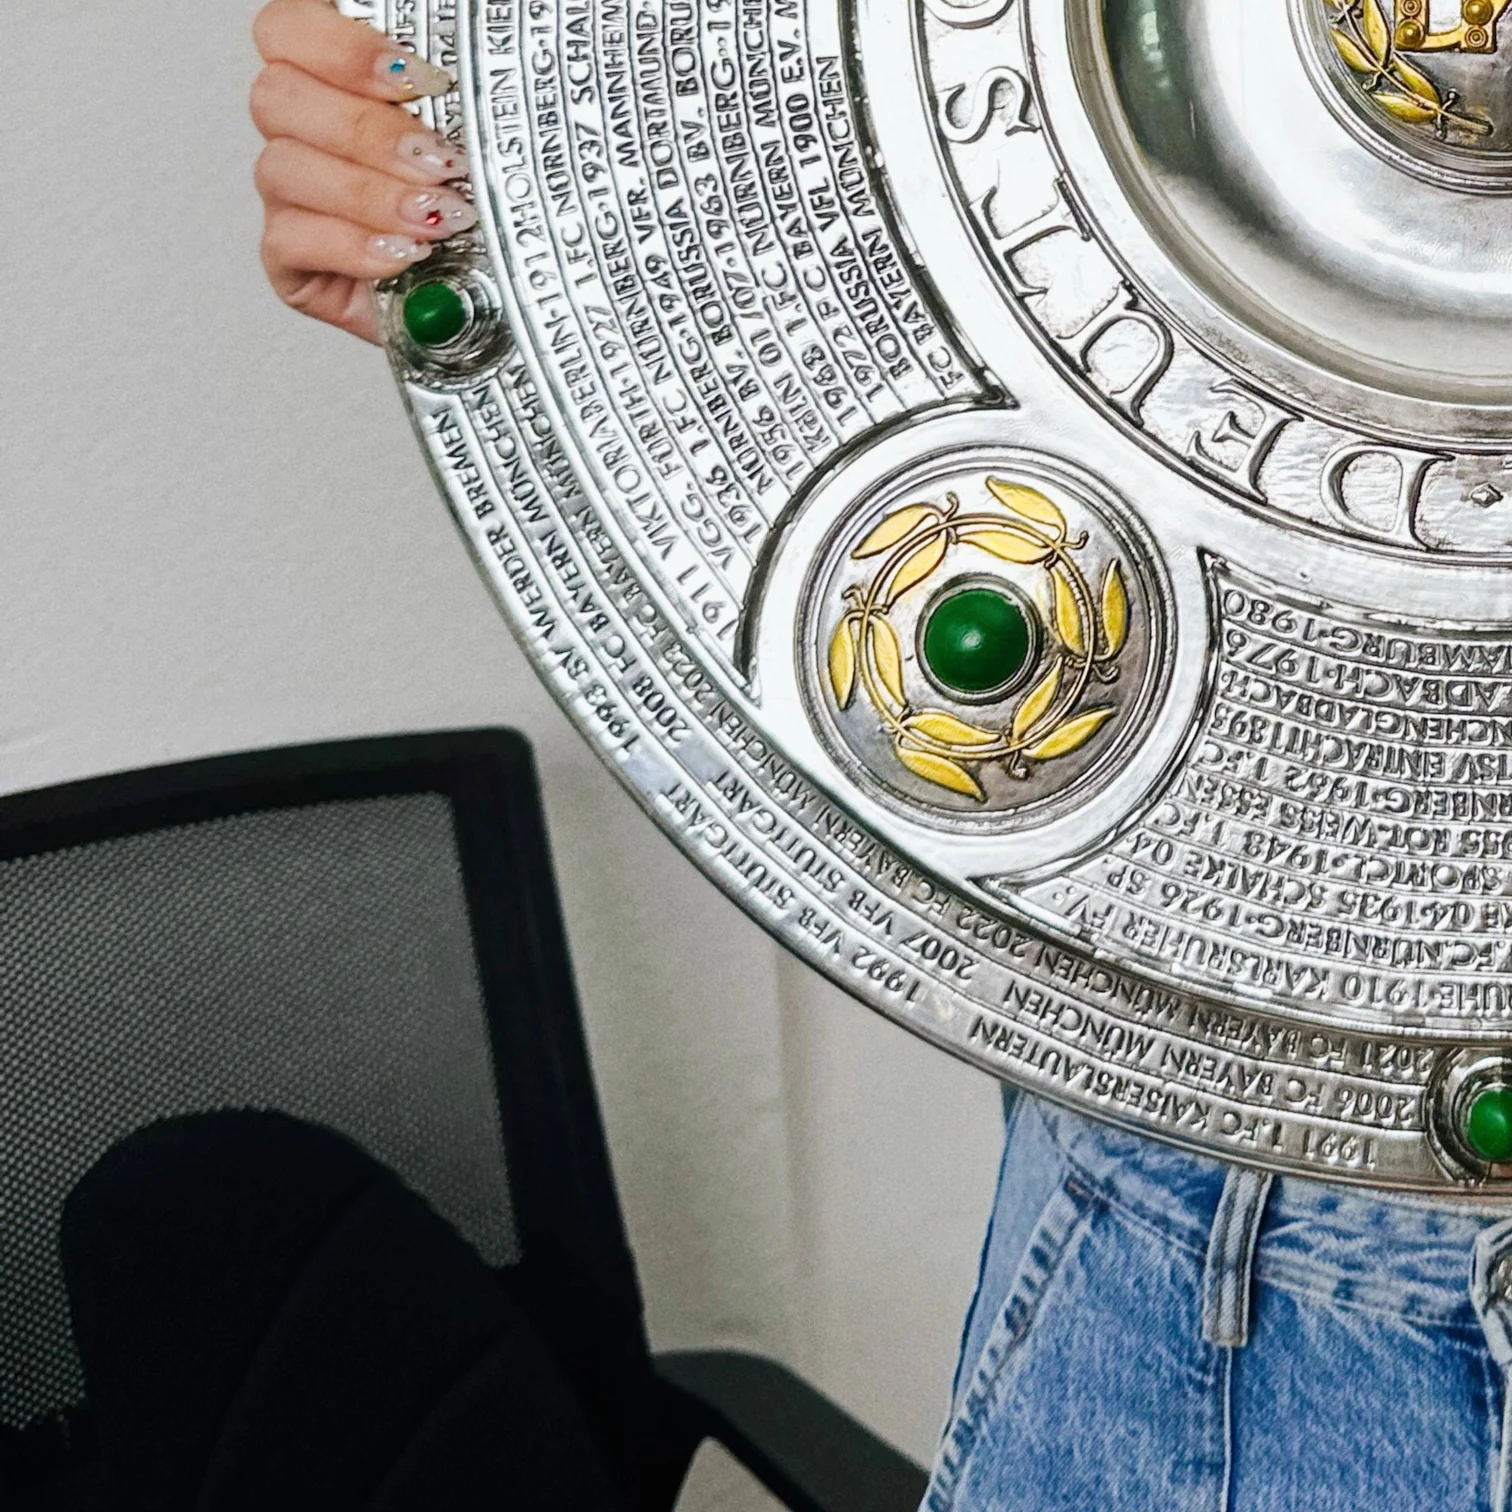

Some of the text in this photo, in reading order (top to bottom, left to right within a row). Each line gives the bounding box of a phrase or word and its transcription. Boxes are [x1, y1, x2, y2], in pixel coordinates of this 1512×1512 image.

[758, 137, 817, 262] BAYERN
[783, 91, 915, 383] BORUSSIA VFL 1900
[663, 194, 735, 346] BORUSSIA
[424, 402, 498, 522] BREMEN
[456, 380, 694, 746] 2008 FC BAYERN MÜNCHEN
[479, 523, 565, 642] WERDER
[549, 638, 593, 684] SV
[651, 775, 926, 1006] 1992 VFB STUTTGART
[704, 764, 980, 985] 2007 VFB STUTTGART
[810, 801, 1034, 963] 2022 FC BAYERN
[964, 1012, 1213, 1138] KAISERSLAUTERN
[1297, 1127, 1379, 1171] 1991
